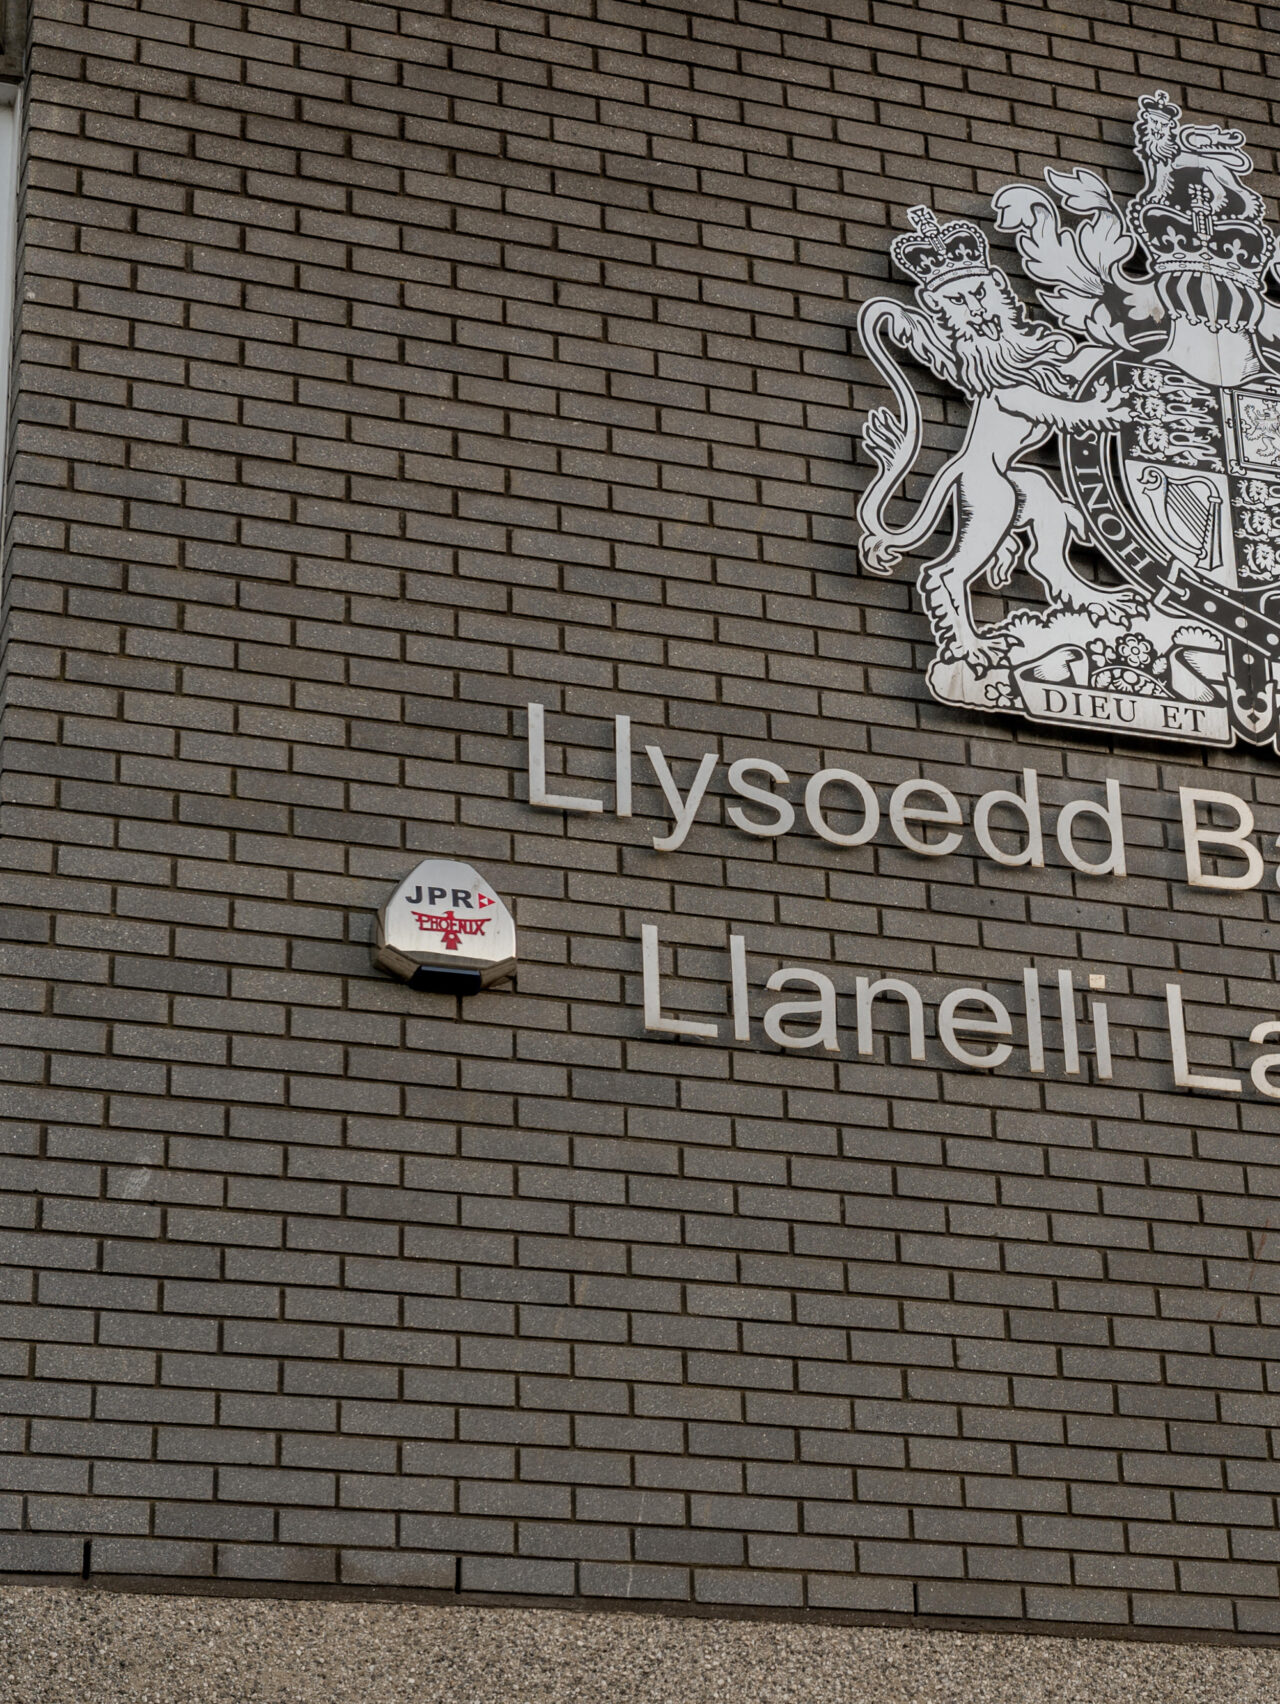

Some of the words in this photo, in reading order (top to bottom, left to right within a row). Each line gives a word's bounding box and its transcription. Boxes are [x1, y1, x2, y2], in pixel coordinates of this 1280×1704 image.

[1075, 465, 1155, 574] HONI
[1042, 687, 1137, 722] DIEU
[1160, 704, 1206, 733] ET
[527, 702, 1127, 878] Llysoedd
[405, 885, 474, 909] JPR
[411, 911, 492, 936] PHOENIX
[641, 923, 1113, 1080] Llanelli
